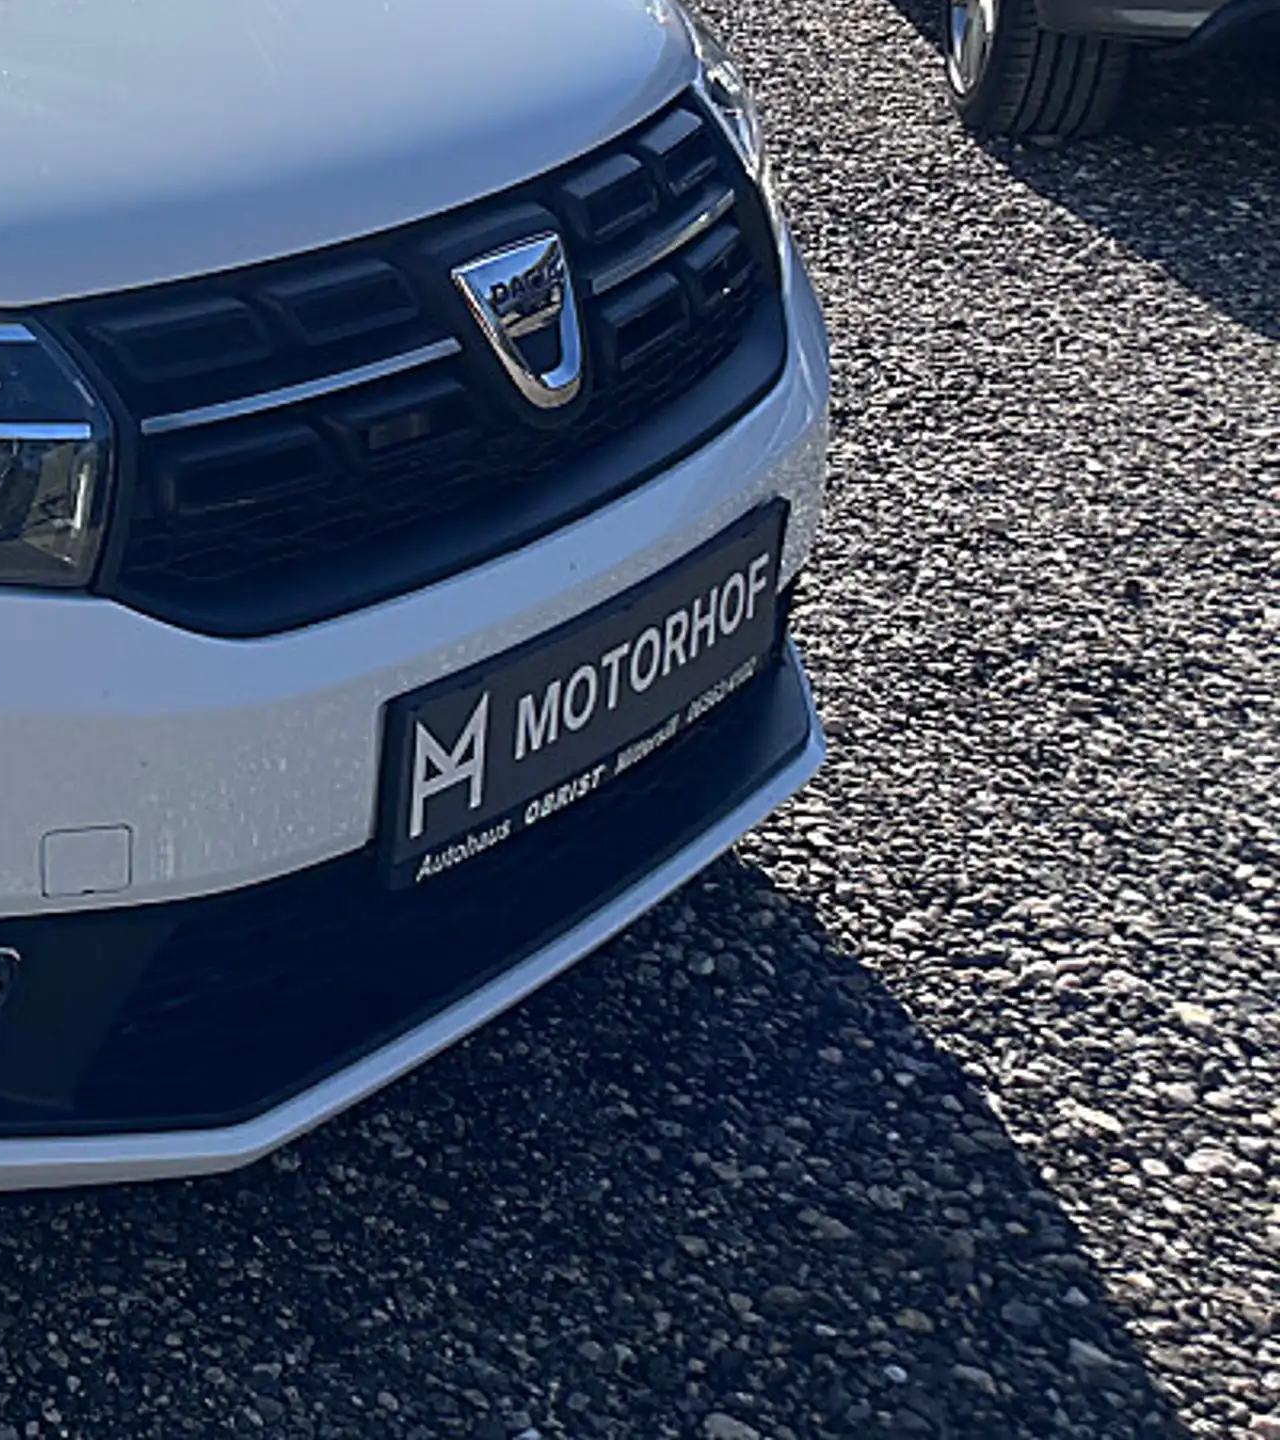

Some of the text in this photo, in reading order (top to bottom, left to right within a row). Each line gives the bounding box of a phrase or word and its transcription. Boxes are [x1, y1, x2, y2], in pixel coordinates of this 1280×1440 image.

[515, 553, 769, 760] MOTORHOF
[415, 764, 606, 882] Autohaus OBRIST
